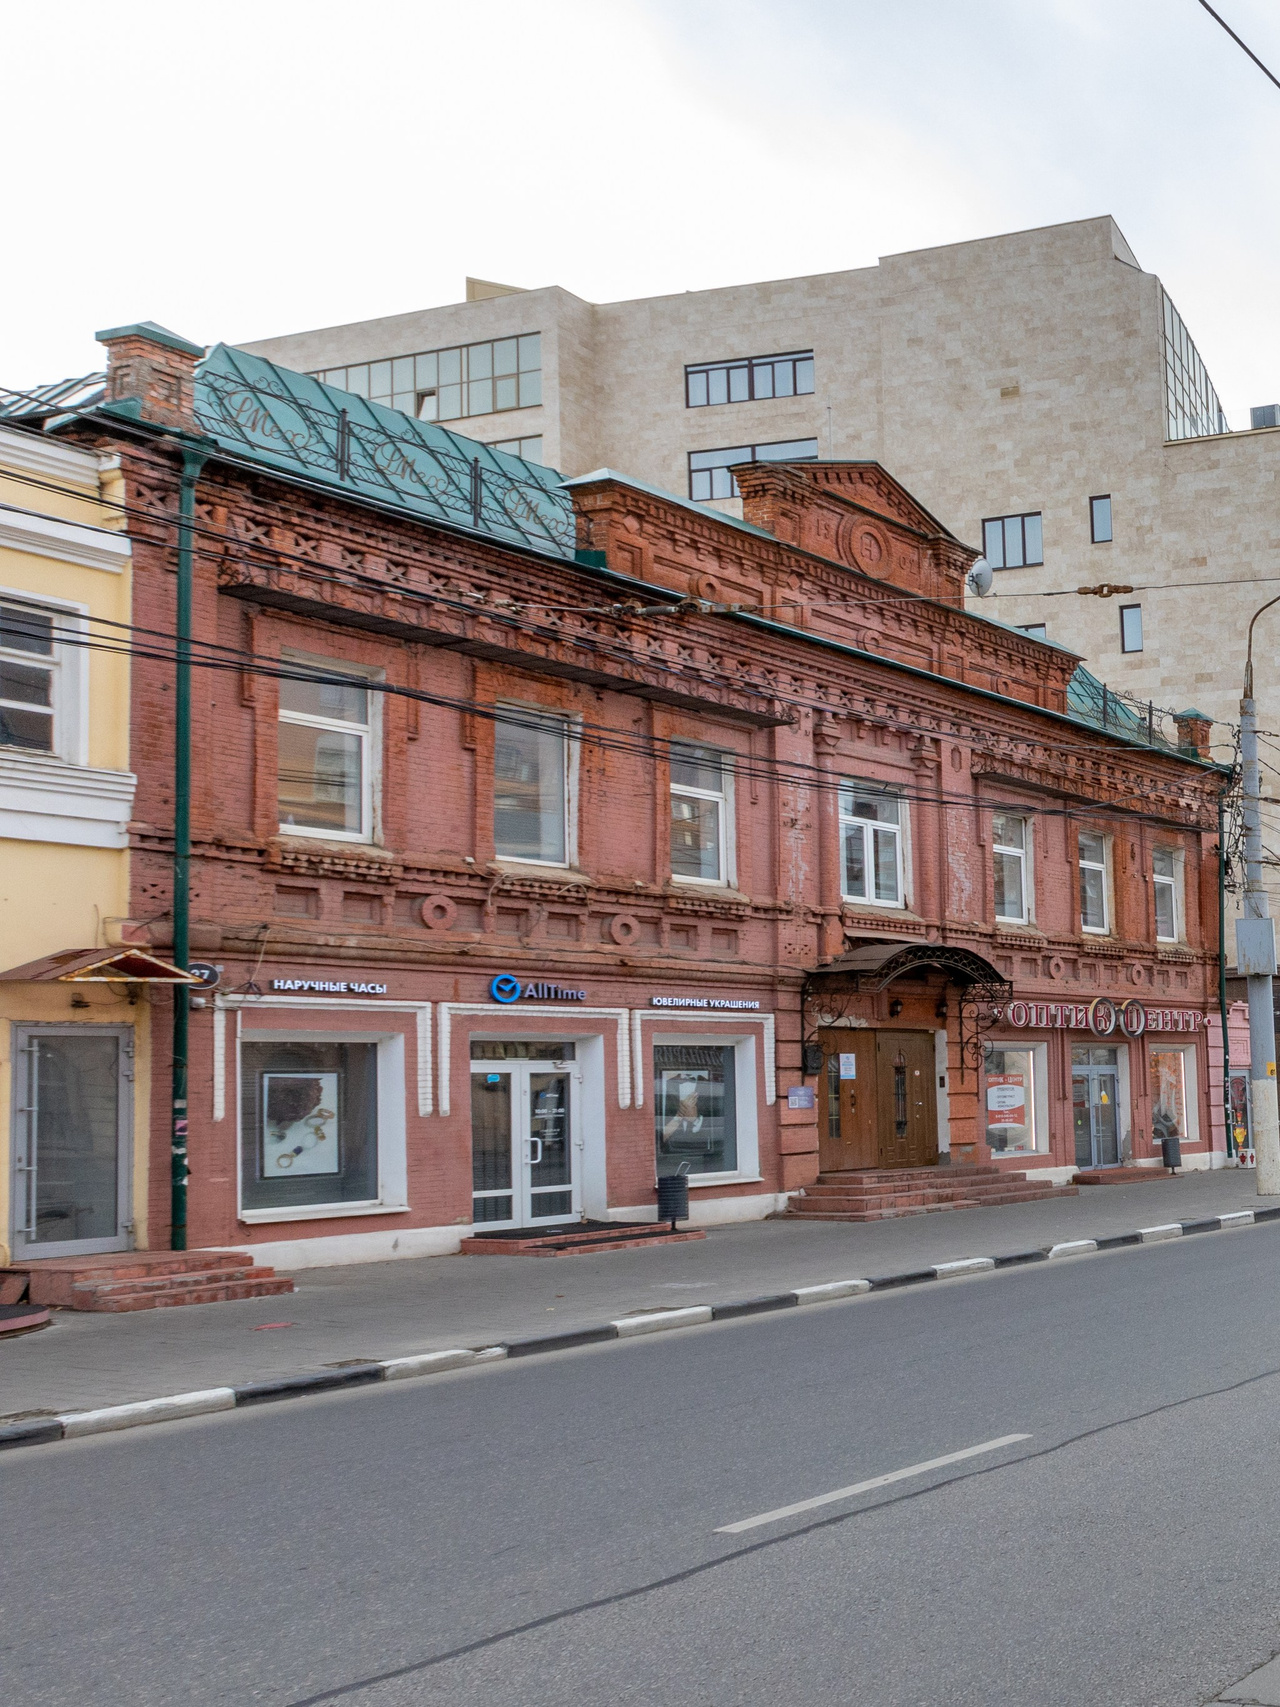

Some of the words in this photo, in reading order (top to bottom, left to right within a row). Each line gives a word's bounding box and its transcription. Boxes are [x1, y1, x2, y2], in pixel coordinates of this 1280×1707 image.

[273, 979, 347, 992] НАРУЧНЫЕ
[350, 982, 387, 994] ЧАСЫ
[524, 983, 587, 1000] AllTime
[652, 997, 708, 1008] ЮВЕЛИРНЫЕ
[709, 999, 760, 1009] УКРАШЕНИЯ
[1008, 1002, 1110, 1030] ОПТИК
[1124, 1007, 1204, 1032] ЦЕНТР
